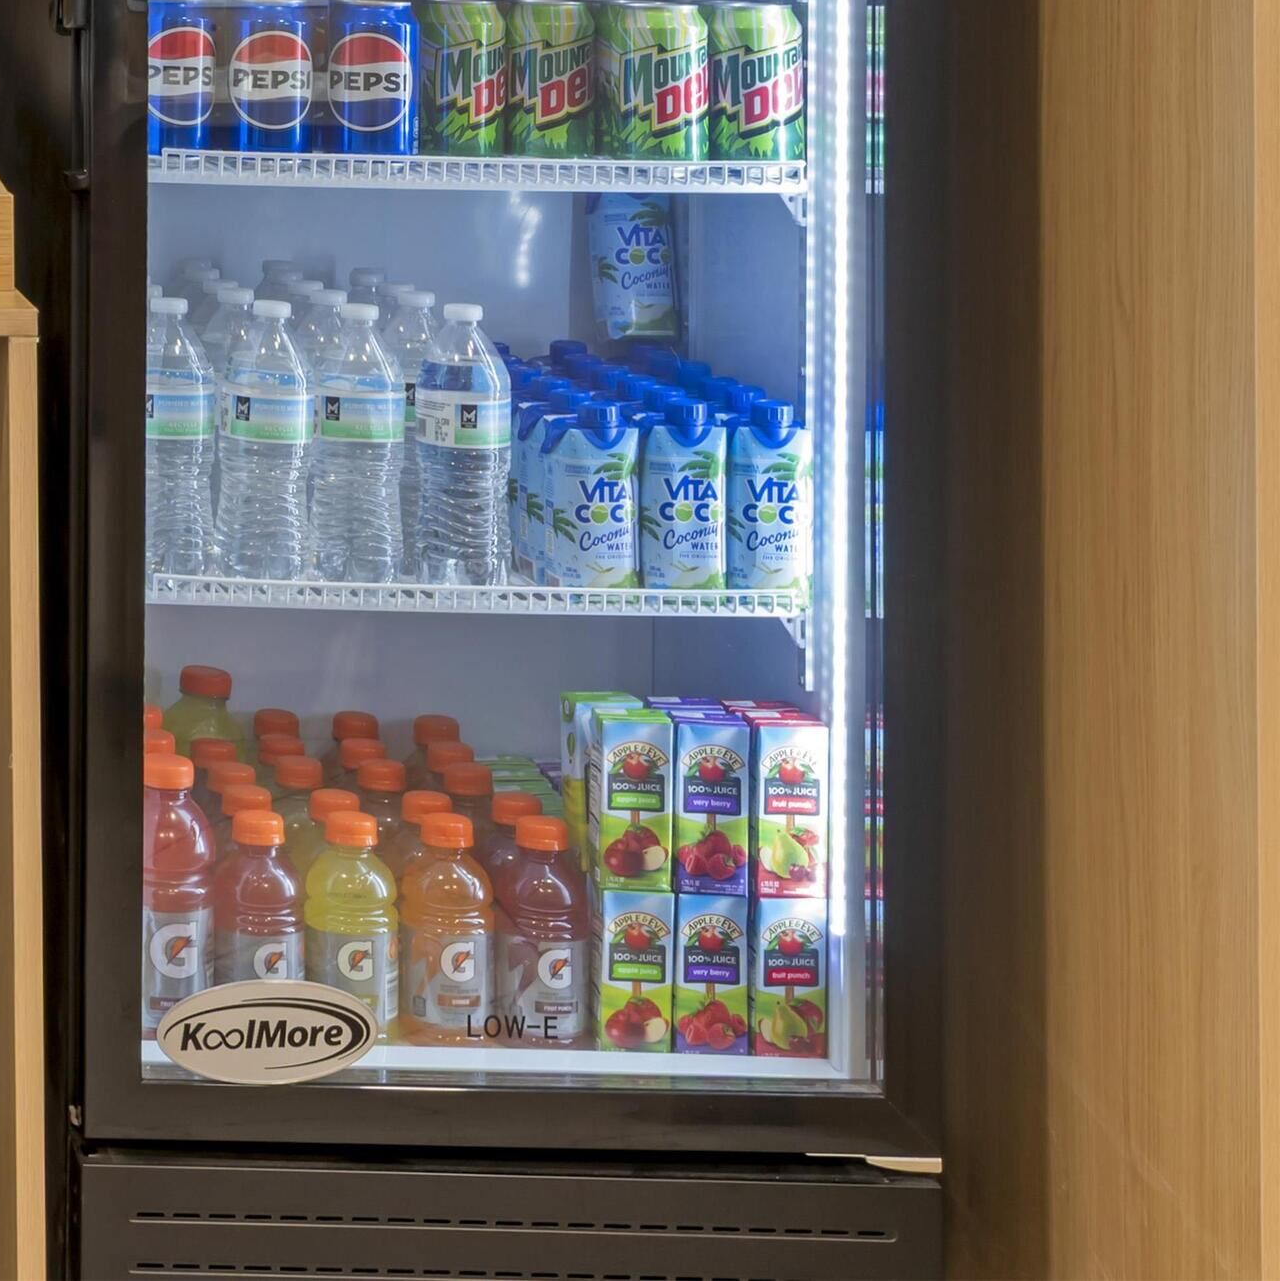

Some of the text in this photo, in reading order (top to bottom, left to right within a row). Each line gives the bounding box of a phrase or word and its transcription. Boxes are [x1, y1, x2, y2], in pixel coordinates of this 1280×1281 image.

[330, 71, 407, 93] PEPSI
[663, 476, 717, 502] VITA
[713, 785, 737, 795] JUICE
[693, 798, 731, 807] very berry
[768, 919, 794, 938] APPLE
[801, 923, 818, 940] EVE
[791, 958, 815, 966] JUICE
[180, 1018, 344, 1052] KoolMore
[467, 1013, 558, 1040] LOW-E
